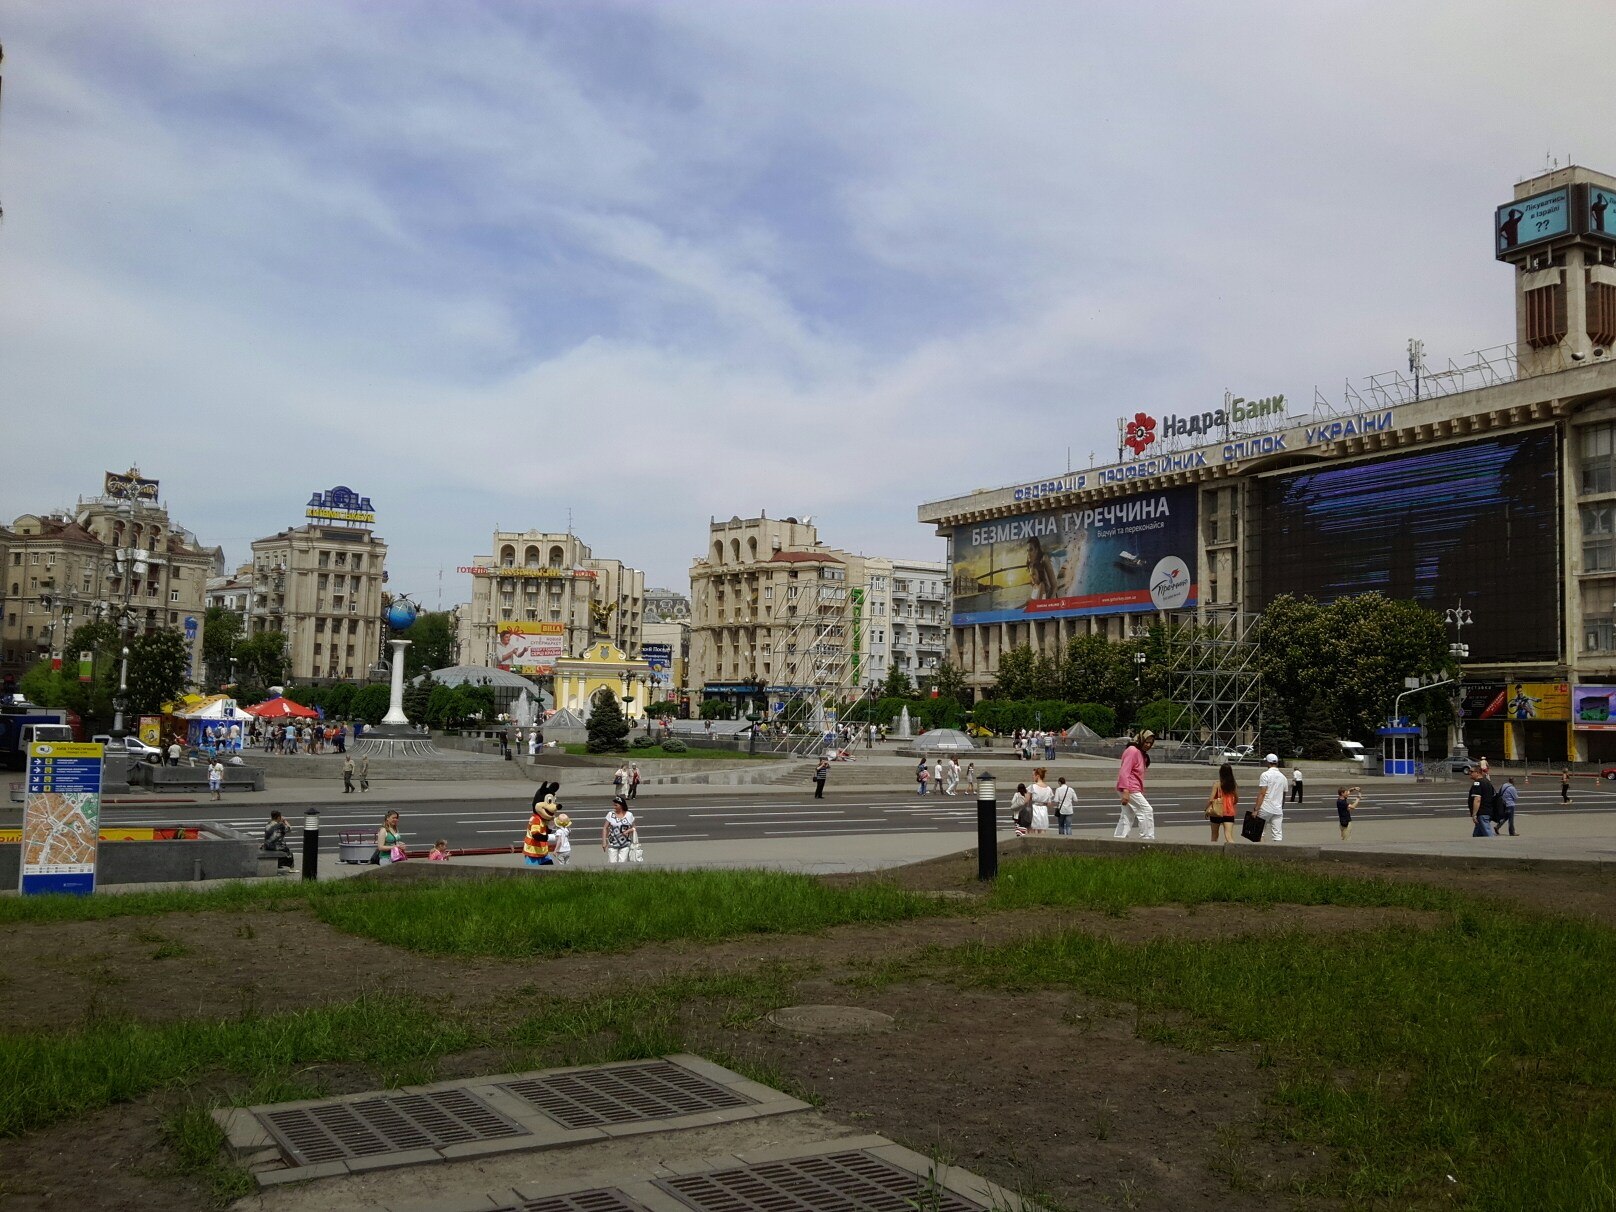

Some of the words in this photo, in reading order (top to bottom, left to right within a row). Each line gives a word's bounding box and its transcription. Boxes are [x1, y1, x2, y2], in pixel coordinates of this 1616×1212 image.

[1525, 196, 1565, 211] Лікуватись
[1536, 206, 1560, 217] Ізраїлі
[1163, 408, 1226, 438] Надра
[1231, 394, 1285, 422] Банк
[1013, 475, 1087, 500] ФЕДЕРАЦІЯ
[1098, 450, 1207, 485] ПРОФЕСІЙНИХ
[1222, 434, 1288, 461] СПІЛОК
[1305, 411, 1394, 445] УКРАЇНИ
[972, 516, 1058, 546] БЕЗМЕЖНА
[1062, 496, 1170, 531] ТУРЕЧЧИНА
[1097, 527, 1117, 538] Відчуй
[1124, 521, 1165, 535] переконайся
